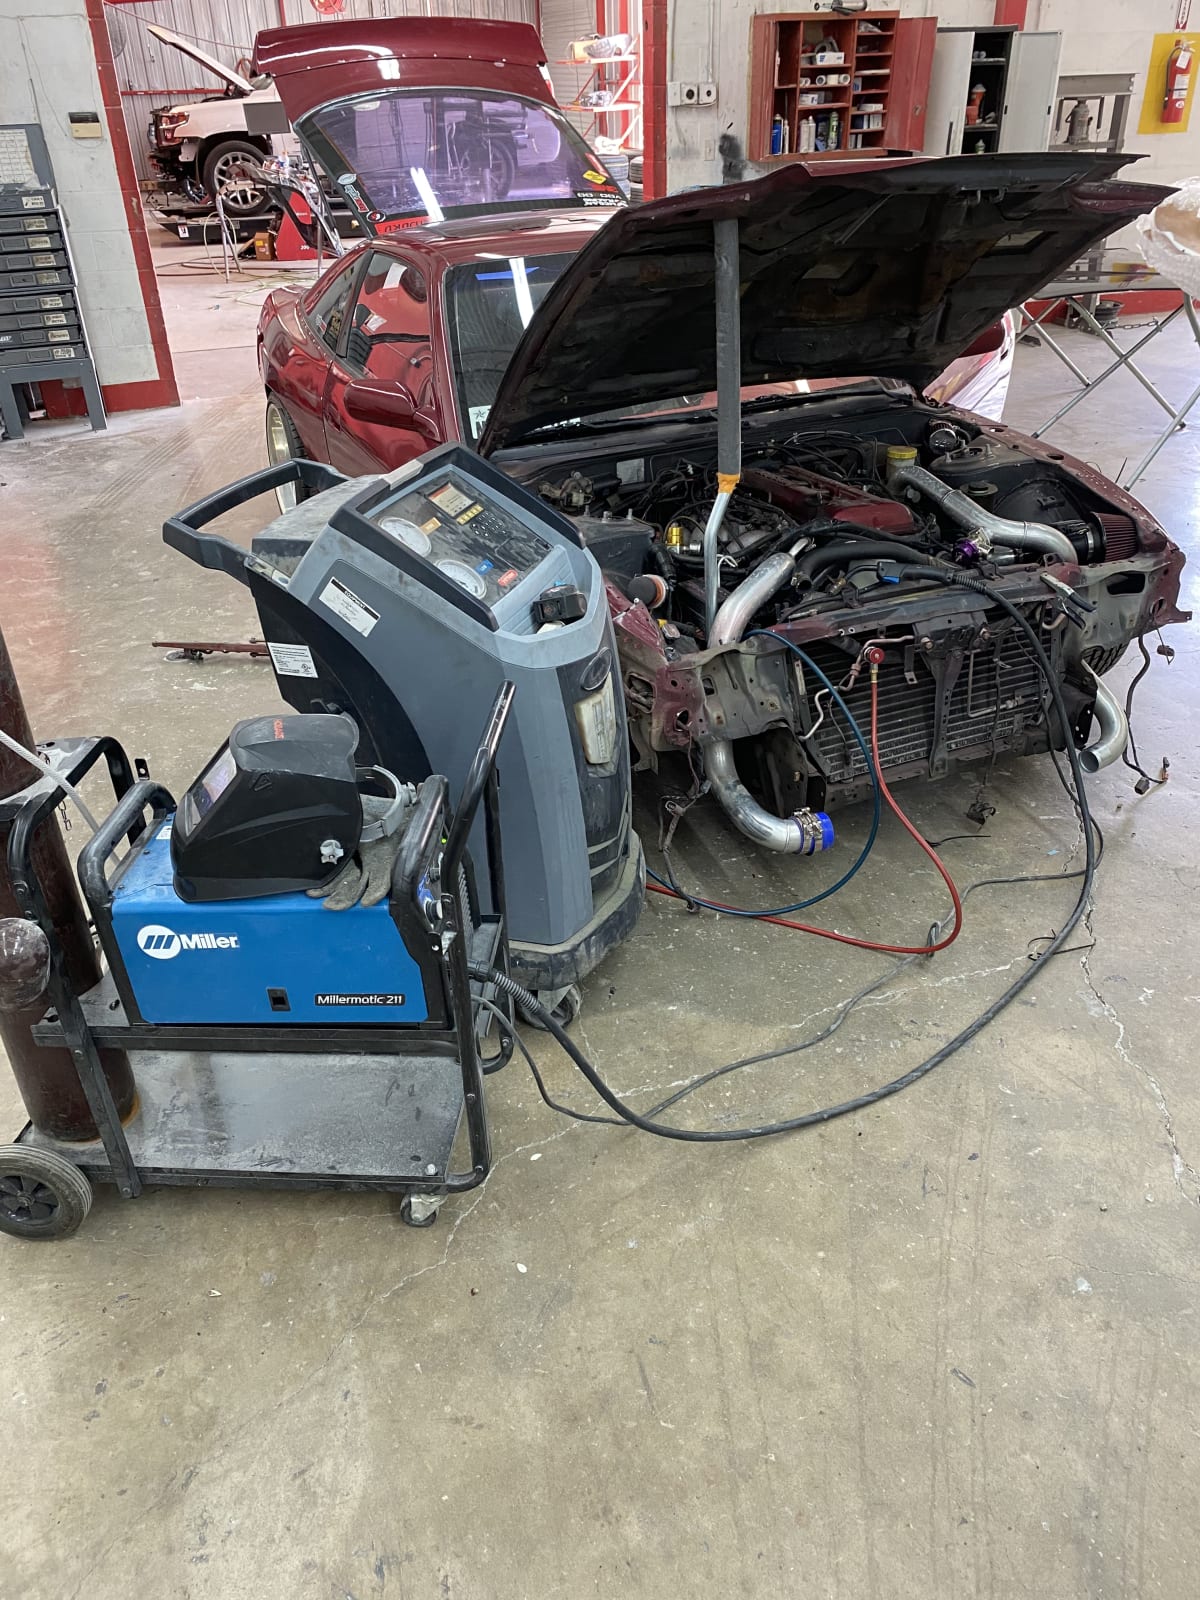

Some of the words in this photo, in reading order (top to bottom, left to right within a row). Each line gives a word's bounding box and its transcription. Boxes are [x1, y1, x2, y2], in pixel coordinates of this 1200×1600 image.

[180, 933, 238, 949] Miller
[317, 995, 383, 1004] Millermatic
[386, 995, 402, 1004] 211
